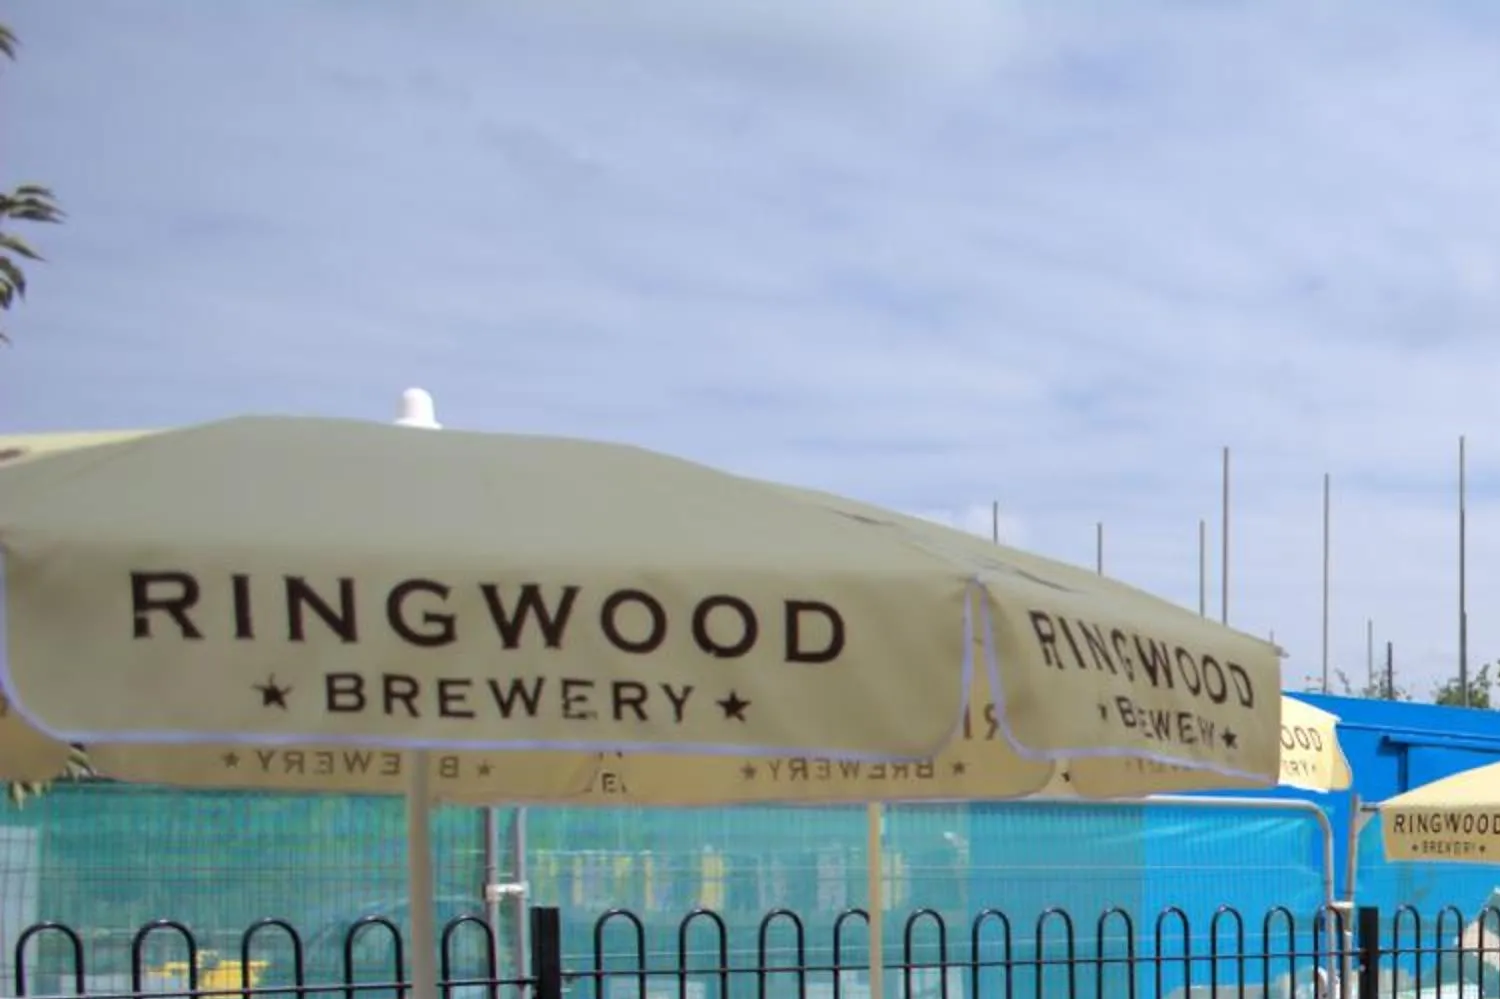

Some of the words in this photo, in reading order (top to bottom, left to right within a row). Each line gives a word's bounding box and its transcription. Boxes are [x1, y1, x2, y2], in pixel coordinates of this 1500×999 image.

[129, 570, 845, 664] RINGWOOD
[1028, 609, 1254, 710] RINGWOOD
[324, 672, 696, 724] BREWERY
